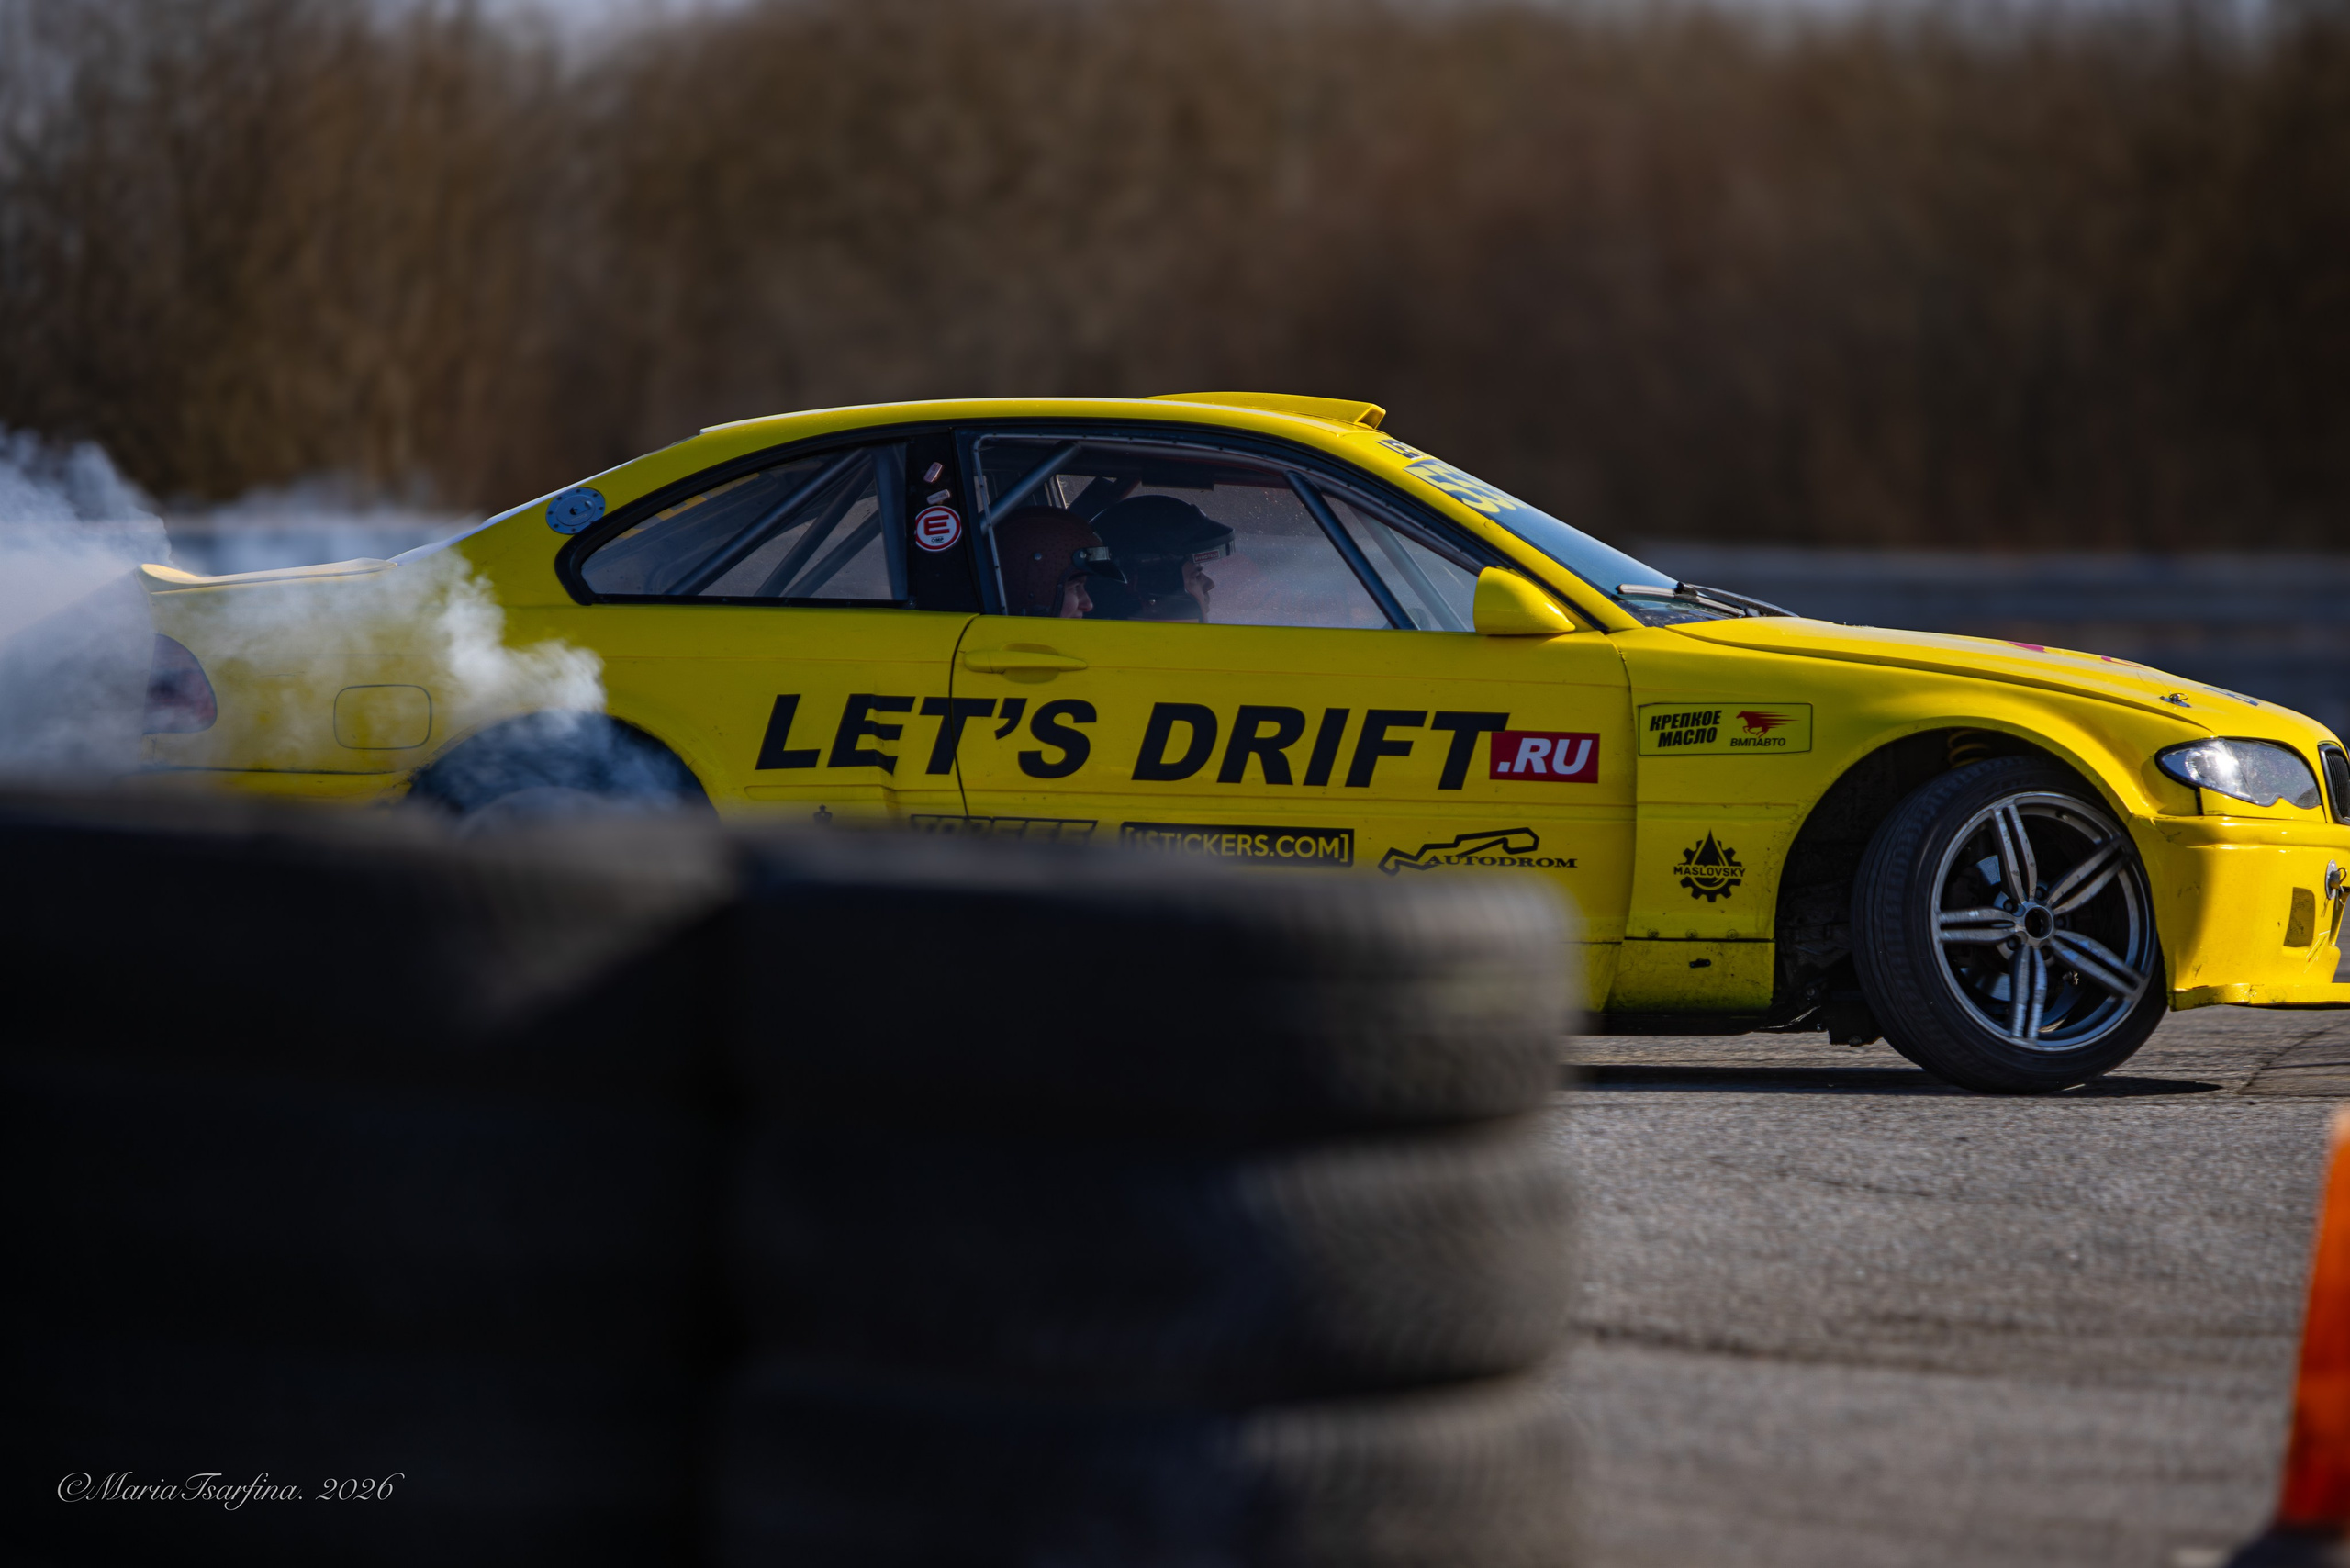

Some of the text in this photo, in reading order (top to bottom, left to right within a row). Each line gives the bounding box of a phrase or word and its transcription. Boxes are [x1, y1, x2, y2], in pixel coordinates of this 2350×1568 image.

[923, 515, 950, 535] E
[1650, 711, 1722, 731] КРЕПКОЕ
[755, 694, 1510, 790] LET'S DRIFT
[1657, 727, 1718, 747] МАСЛО
[1730, 738, 1786, 747] ВМПАВТО
[1497, 737, 1593, 775] .RU
[1424, 855, 1578, 868] AUTODROM
[1673, 867, 1746, 877] MASLOVSKY
